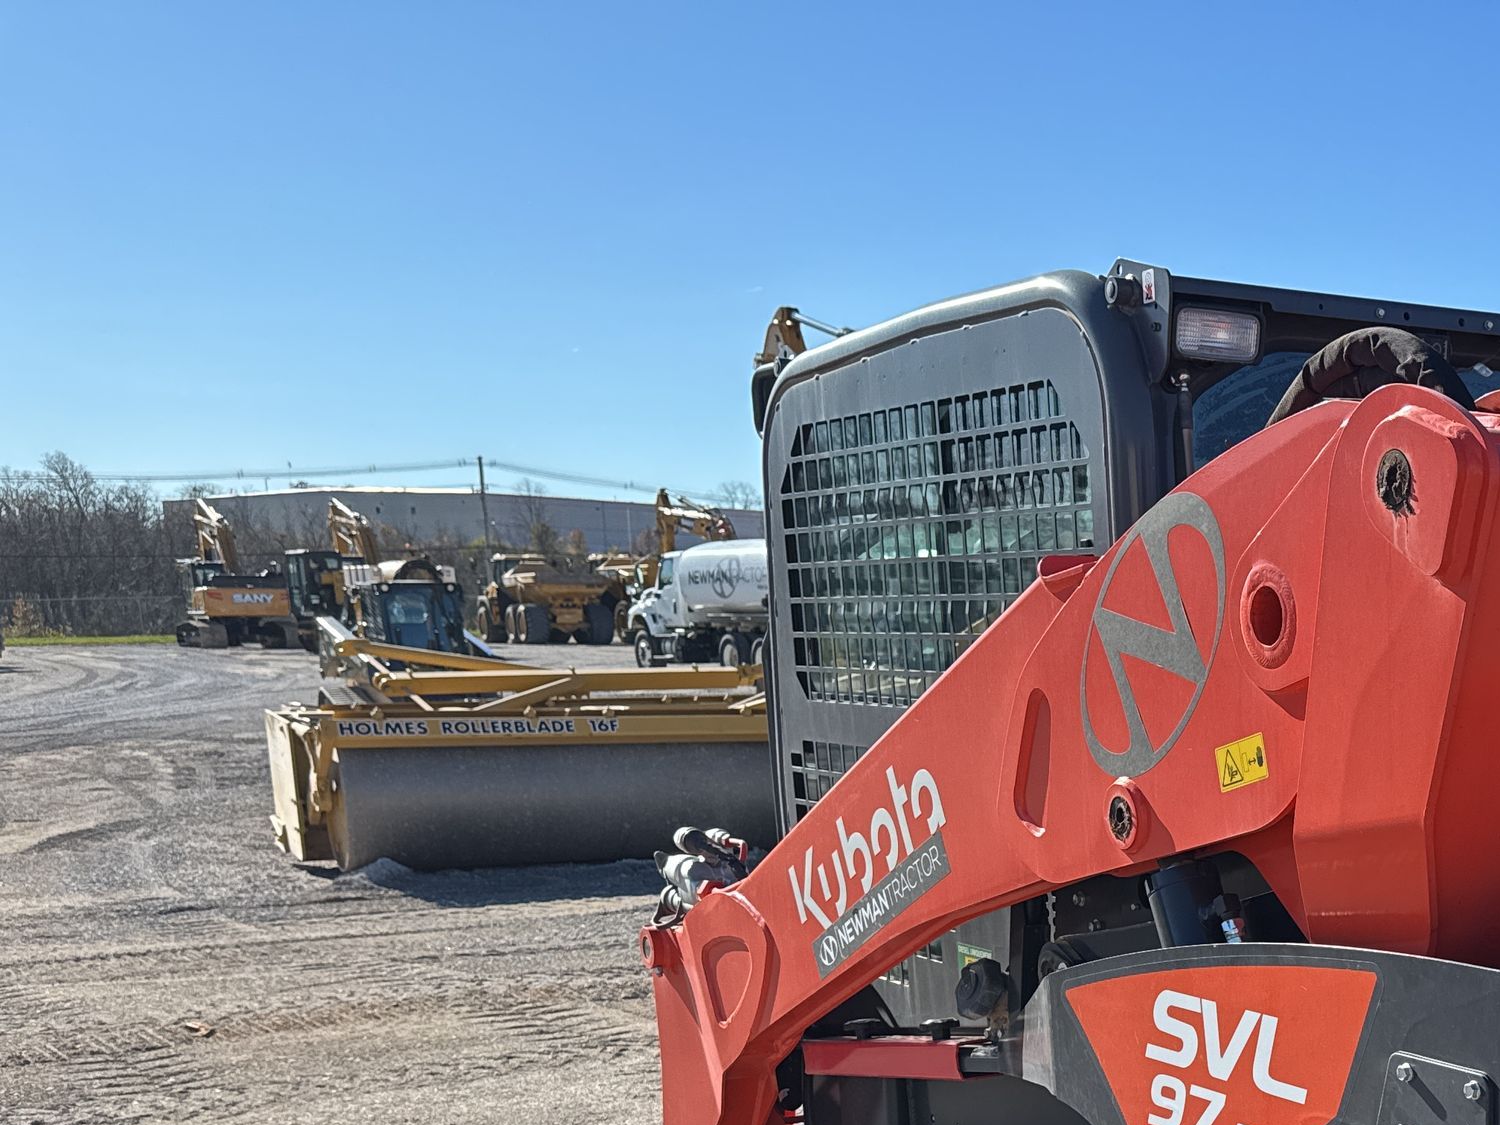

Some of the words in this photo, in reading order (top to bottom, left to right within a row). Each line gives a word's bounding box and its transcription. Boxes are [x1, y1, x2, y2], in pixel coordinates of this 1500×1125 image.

[232, 593, 274, 604] SANY
[338, 720, 429, 736] HOLMES
[441, 719, 576, 735] ROLLERBLADE
[588, 718, 619, 733] 16F
[788, 765, 947, 930] Kubota
[1145, 989, 1308, 1105] SVL
